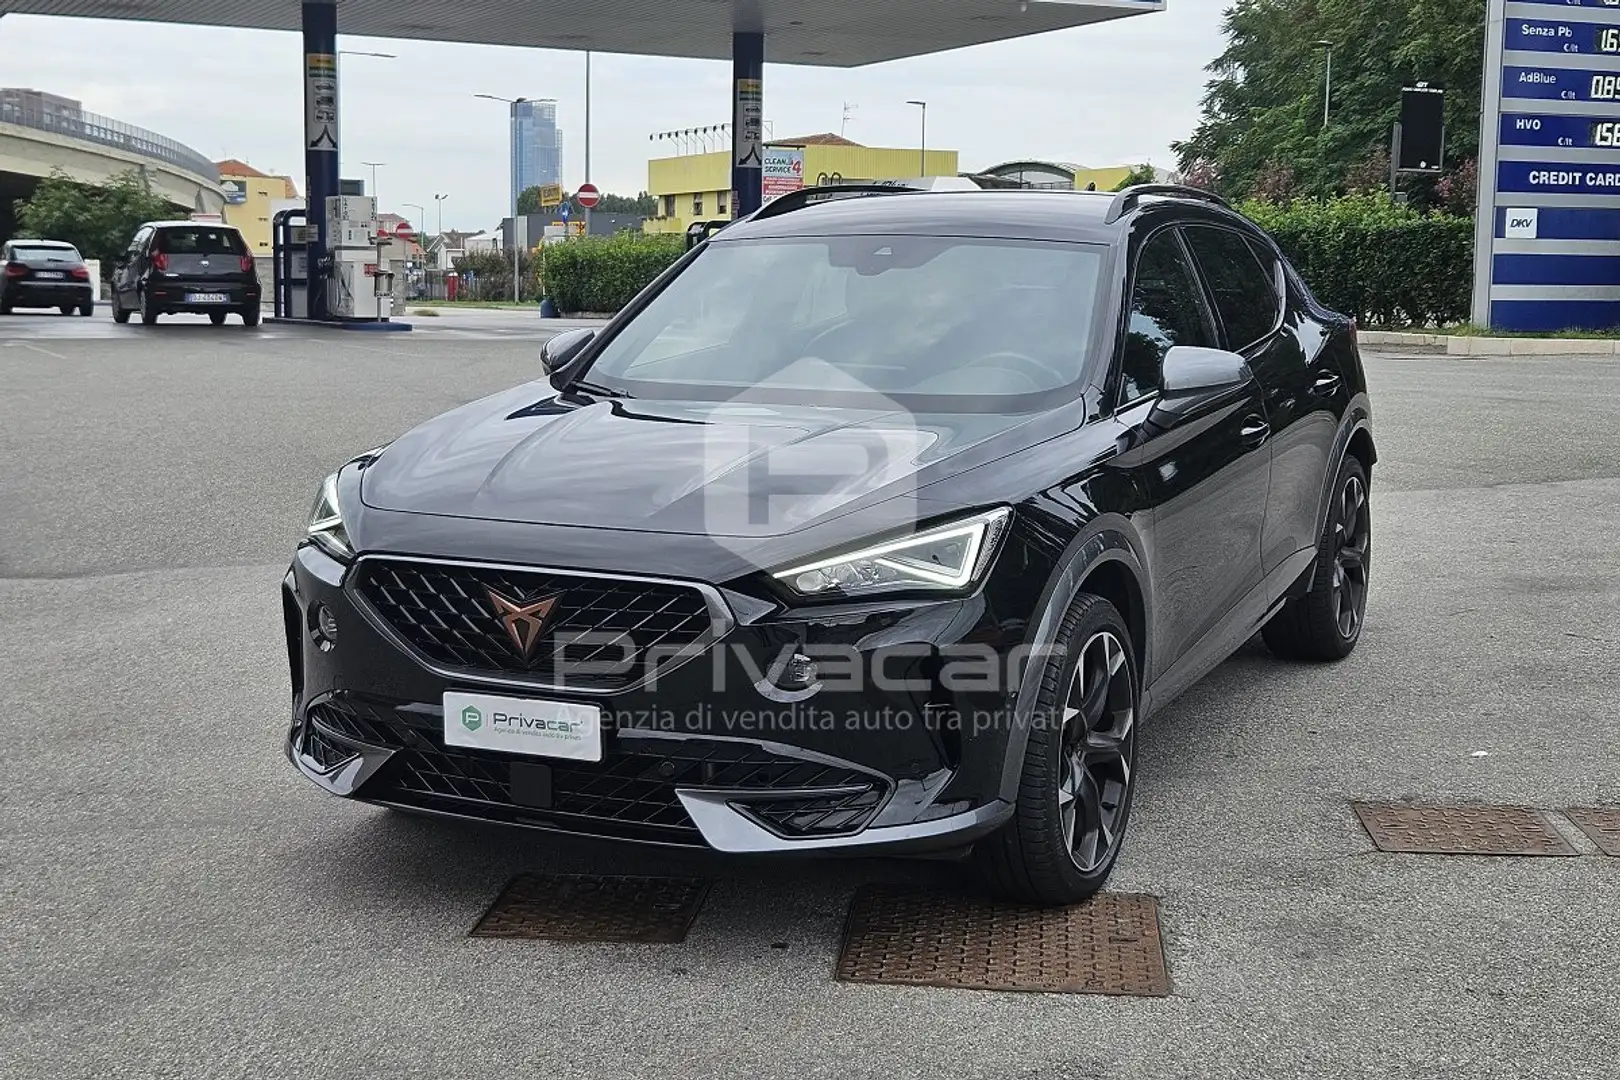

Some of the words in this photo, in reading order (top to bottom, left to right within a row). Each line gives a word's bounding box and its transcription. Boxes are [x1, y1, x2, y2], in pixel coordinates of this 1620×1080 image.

[1521, 24, 1555, 37] Senza
[1558, 27, 1573, 37] Pb
[1519, 72, 1557, 84] AdBlue
[1516, 119, 1541, 130] HVO
[1529, 170, 1582, 185] CREDIT
[1510, 218, 1533, 228] DKV
[493, 713, 582, 733] Privacar
